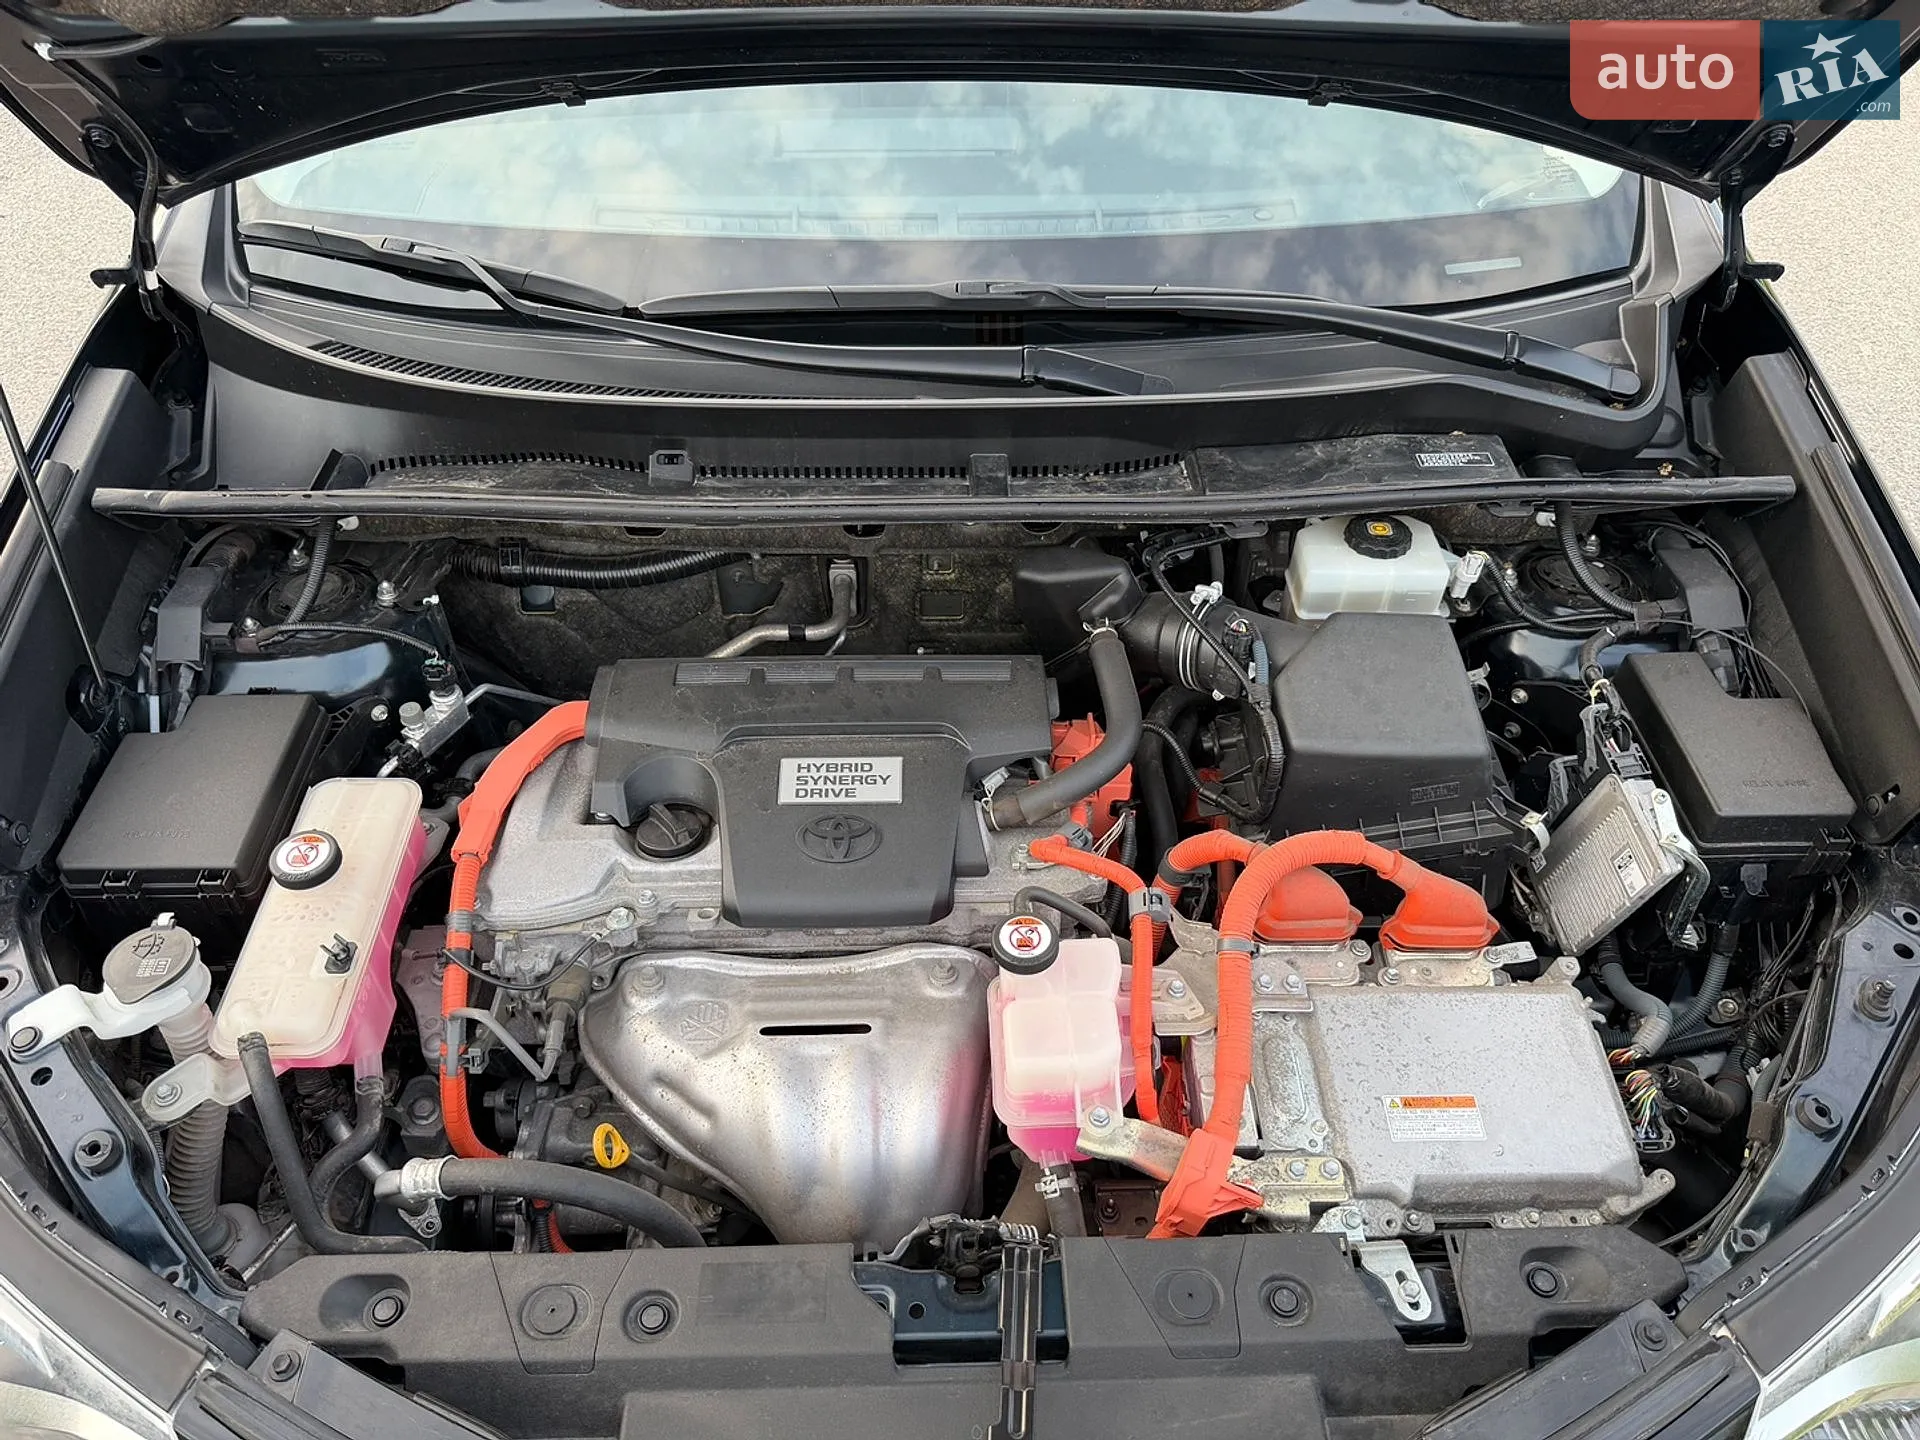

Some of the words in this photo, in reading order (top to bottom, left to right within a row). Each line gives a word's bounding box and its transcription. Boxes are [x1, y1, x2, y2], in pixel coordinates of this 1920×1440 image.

[797, 763, 873, 773] HYBRID
[796, 775, 892, 786] SYNERGY
[795, 788, 857, 798] DRIVE
